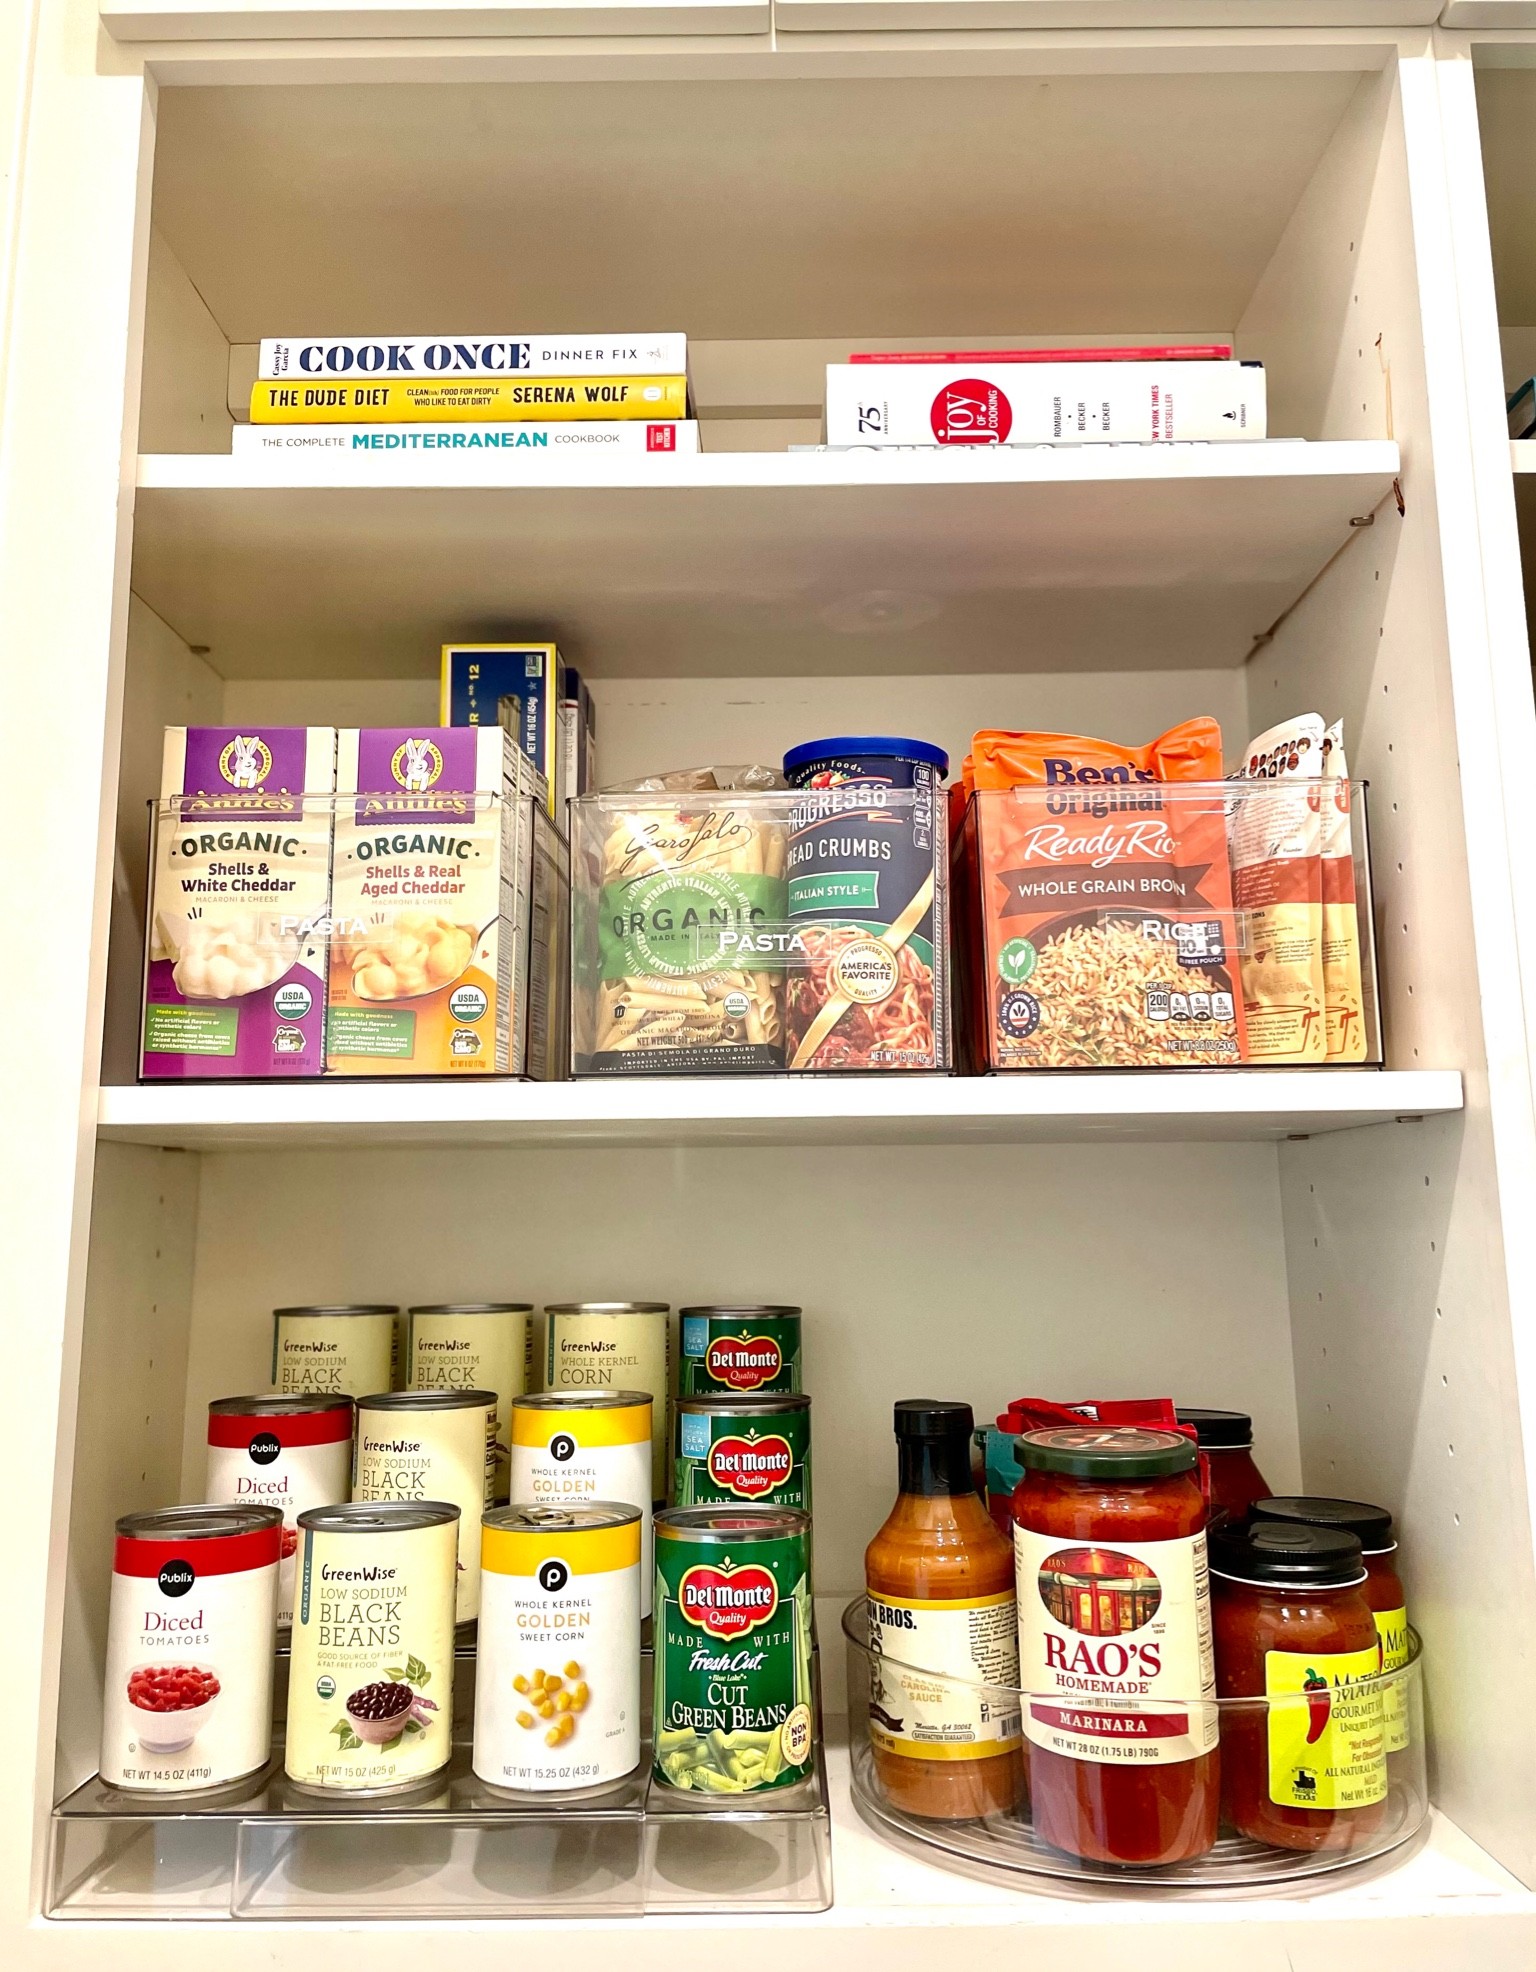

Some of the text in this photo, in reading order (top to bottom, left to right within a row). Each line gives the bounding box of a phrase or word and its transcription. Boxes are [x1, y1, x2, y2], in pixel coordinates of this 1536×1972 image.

[273, 343, 282, 376] Cassy Joy
[281, 348, 289, 371] Garcia
[299, 343, 531, 372] COOK ONCE
[542, 349, 638, 361] DINNER FIX
[269, 388, 390, 406] THE DUDE DIET
[474, 387, 500, 395] PEOPLE
[513, 385, 629, 403] SERENA WOLF
[414, 398, 431, 406] WHO
[457, 397, 470, 405] EAT
[471, 397, 491, 405] DIRTY
[987, 389, 998, 429] COOKING
[1151, 385, 1159, 430] YORK TIMES
[858, 406, 881, 434] 75
[976, 414, 986, 426] OF
[1053, 396, 1061, 437] ROMBAUER
[1078, 402, 1086, 431] BECKER
[1102, 402, 1110, 431] BECKER
[1165, 394, 1173, 438] BESTSELLER
[262, 432, 620, 449] THE COMPLETE MEDITERRANEAN COOKBOOK
[469, 664, 480, 680] 12
[796, 761, 827, 784] Quality
[1043, 758, 1156, 786] Ben's
[1046, 785, 1164, 819] Original
[181, 832, 300, 857] ORGANIC
[356, 834, 473, 861] ORGANIC
[619, 811, 752, 874] Garofalo
[818, 838, 892, 861] CRUMBS
[1023, 823, 1127, 869] Ready
[208, 862, 270, 876] Shells &
[366, 865, 461, 879] Shells & Real
[181, 878, 296, 892] White Cheddar
[361, 881, 466, 898] Aged Cheddar
[794, 884, 860, 901] ITALIAN STYLE
[1018, 880, 1078, 897] WHOLE
[1081, 879, 1135, 894] GRAIN
[640, 877, 720, 911] AUTHENTIC ITALIAN
[280, 915, 368, 935] PASTA
[613, 907, 766, 938] ORGANIC
[650, 934, 676, 942] MADE
[719, 931, 808, 952] PASTA
[850, 945, 883, 956] PROGRESSO
[840, 962, 892, 971] AMERICA'S
[841, 971, 891, 980] FAVORITE
[282, 992, 304, 1000] USDA
[457, 994, 479, 1003] USDA
[854, 988, 878, 996] QUALITY
[1149, 994, 1168, 1006] 200
[283, 1339, 338, 1352] GreenWise
[561, 1338, 617, 1353] GreenWise
[686, 1336, 704, 1351] SEA SALT
[283, 1356, 347, 1366] LOW SODIUM
[560, 1355, 639, 1367] WHOLE KERNEL
[711, 1351, 778, 1368] Del Monte
[282, 1368, 343, 1384] BLACK
[560, 1368, 613, 1385] CORN
[730, 1370, 759, 1382] Quality
[250, 1444, 279, 1453] Publix
[363, 1436, 421, 1453] GreenWise
[714, 1453, 789, 1473] Del Monte
[236, 1476, 289, 1495] Diced
[362, 1470, 426, 1489] BLACK
[160, 1572, 193, 1583] Publix
[321, 1563, 397, 1582] GreenWise
[302, 1560, 311, 1618] ORGANIC
[320, 1586, 408, 1600] LOW SODIUM
[686, 1584, 773, 1607] Del Monte
[319, 1601, 402, 1624] BLACK
[514, 1599, 592, 1609] WHOLE KERNEL
[143, 1610, 204, 1632] Diced
[516, 1612, 591, 1628] GOLDEN
[709, 1611, 747, 1626] Quality
[879, 1605, 918, 1630] BROS.
[140, 1634, 210, 1646] TOMATOES
[318, 1625, 400, 1647] BEANS
[520, 1632, 585, 1642] SWEET CORN
[668, 1631, 790, 1648] MADE WITH
[688, 1649, 731, 1672] Fresh
[1043, 1632, 1162, 1678] RAO'S
[1055, 1673, 1150, 1694] HOMEMADE
[707, 1683, 749, 1706] CUT
[908, 1692, 943, 1703] SAUCE
[672, 1701, 787, 1729] GREEN BEANS
[1331, 1704, 1374, 1719] GOURMET
[791, 1723, 807, 1737] NON
[1059, 1711, 1148, 1733] MARINARA
[1340, 1720, 1368, 1733] UNIQUELY
[792, 1735, 807, 1749] BPA
[123, 1766, 212, 1781] NET WT 14.5 OZ (411g)
[1324, 1766, 1339, 1777] ALL
[1340, 1764, 1370, 1776] NATURAL
[1294, 1793, 1316, 1802] TEXAS
